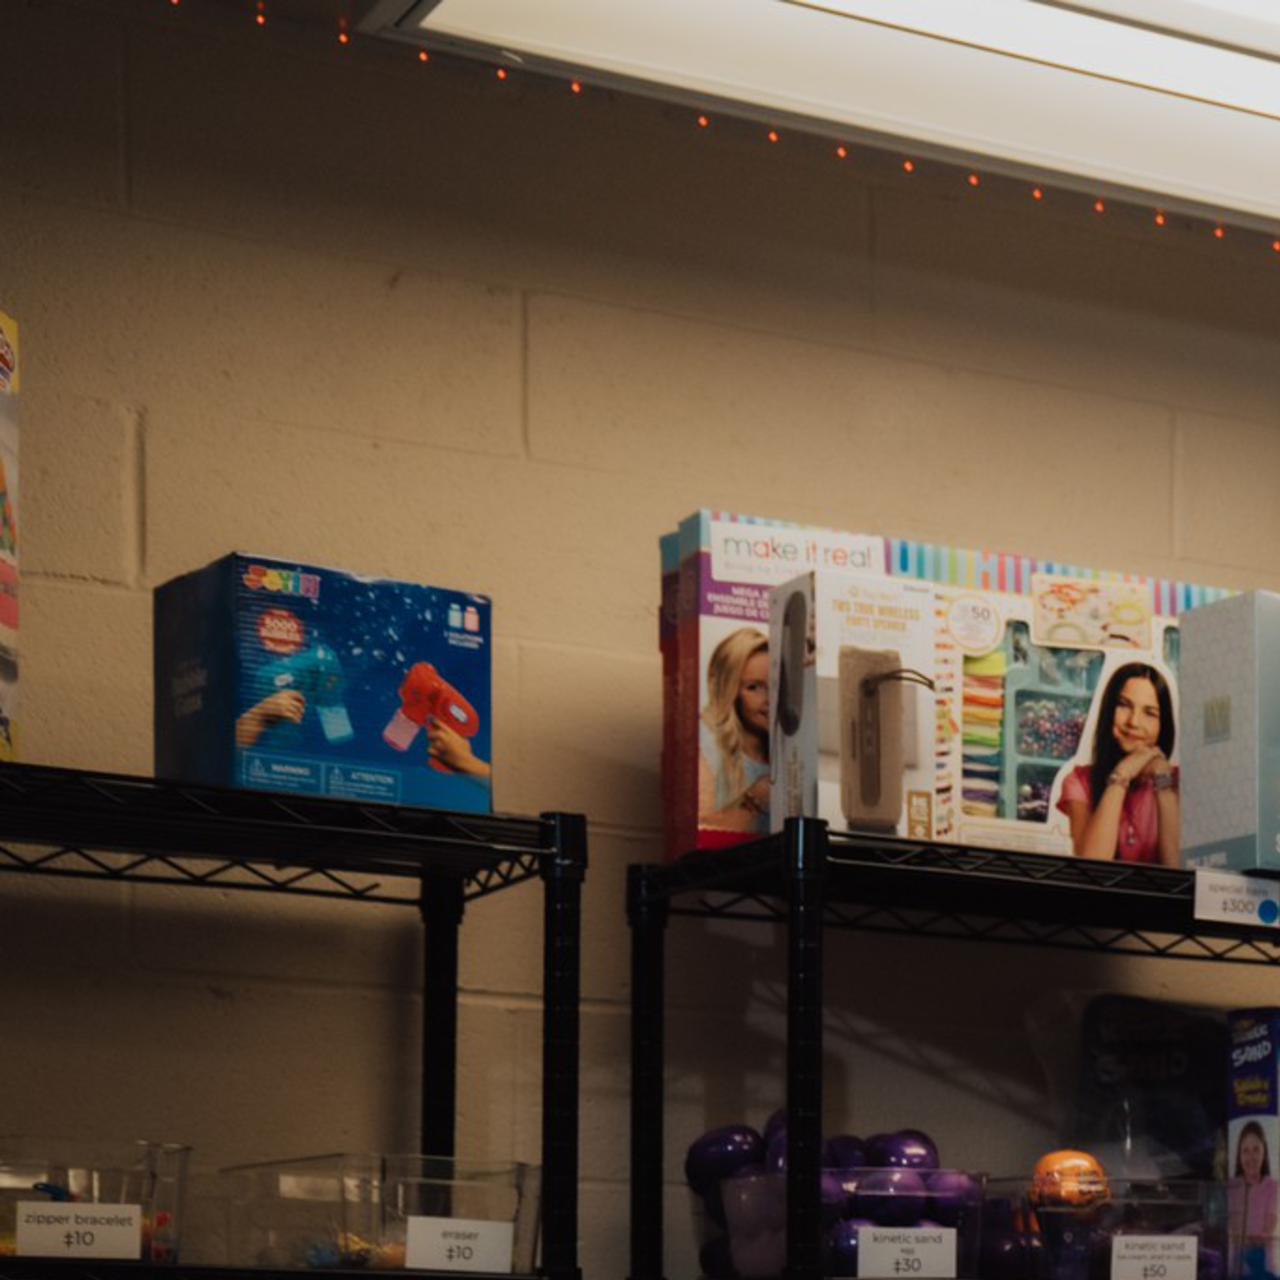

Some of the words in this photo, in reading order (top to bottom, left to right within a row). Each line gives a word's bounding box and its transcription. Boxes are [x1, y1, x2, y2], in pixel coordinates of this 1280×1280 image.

[723, 535, 798, 560] make
[805, 538, 818, 563] it
[823, 546, 872, 569] real
[1208, 882, 1246, 897] special
[24, 1213, 70, 1227] zipper
[74, 1213, 134, 1227] bracelet
[441, 1230, 480, 1241] eraser
[873, 1233, 912, 1245] kinetic
[914, 1233, 943, 1245] sand
[1124, 1241, 1159, 1251] kinetic
[1160, 1241, 1186, 1251] sand
